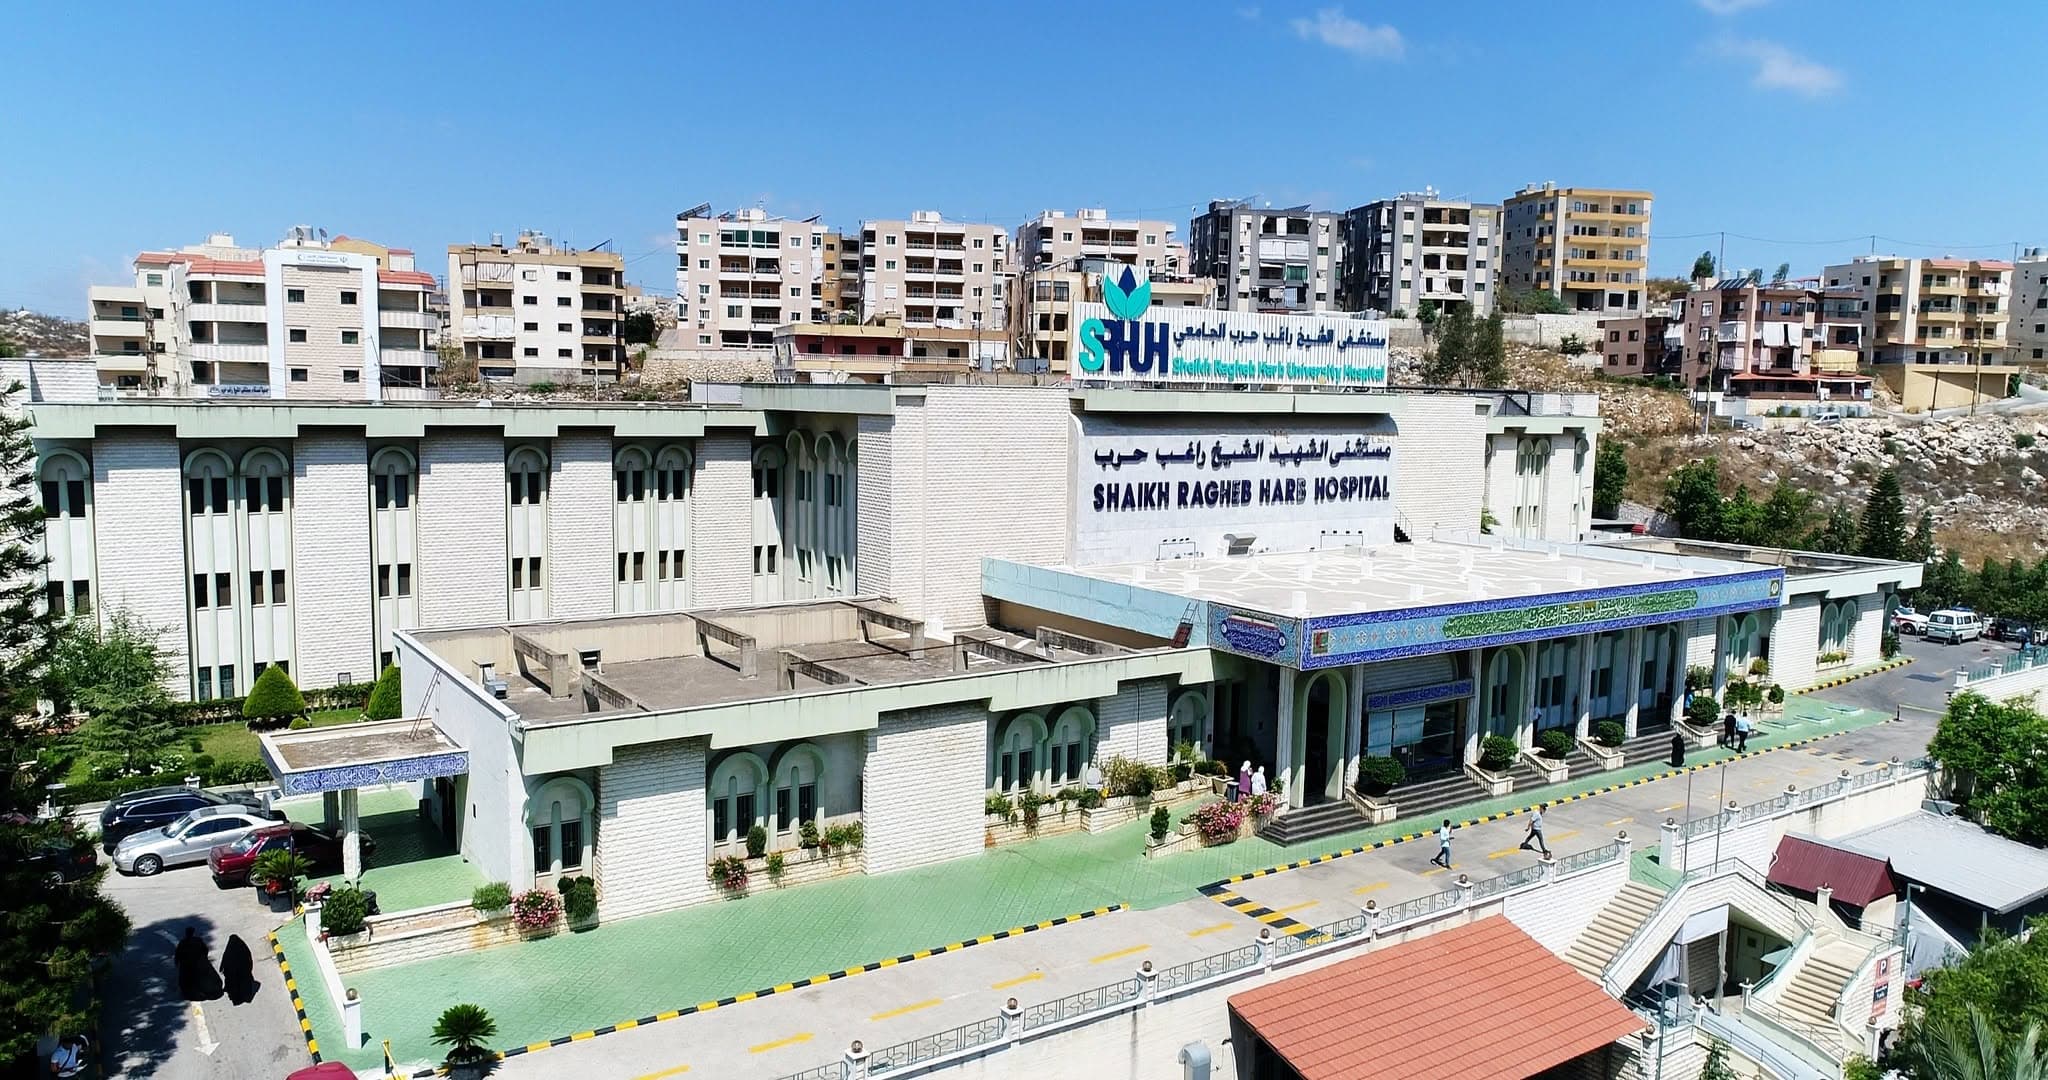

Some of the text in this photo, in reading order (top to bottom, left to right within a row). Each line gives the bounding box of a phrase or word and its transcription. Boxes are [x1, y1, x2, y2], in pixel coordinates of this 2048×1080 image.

[1173, 322, 1226, 348] الجامعي
[1229, 329, 1259, 348] حرب
[1263, 326, 1293, 349] راغب
[1296, 325, 1334, 350] الشيخ
[1286, 362, 1342, 384] University
[1343, 364, 1386, 384] Hospital
[1094, 438, 1391, 471] مستشفى الشهيد الشيخ راغب حرب
[1093, 476, 1390, 512] SHAIKH RAGHEB HARB HOSPITAL
